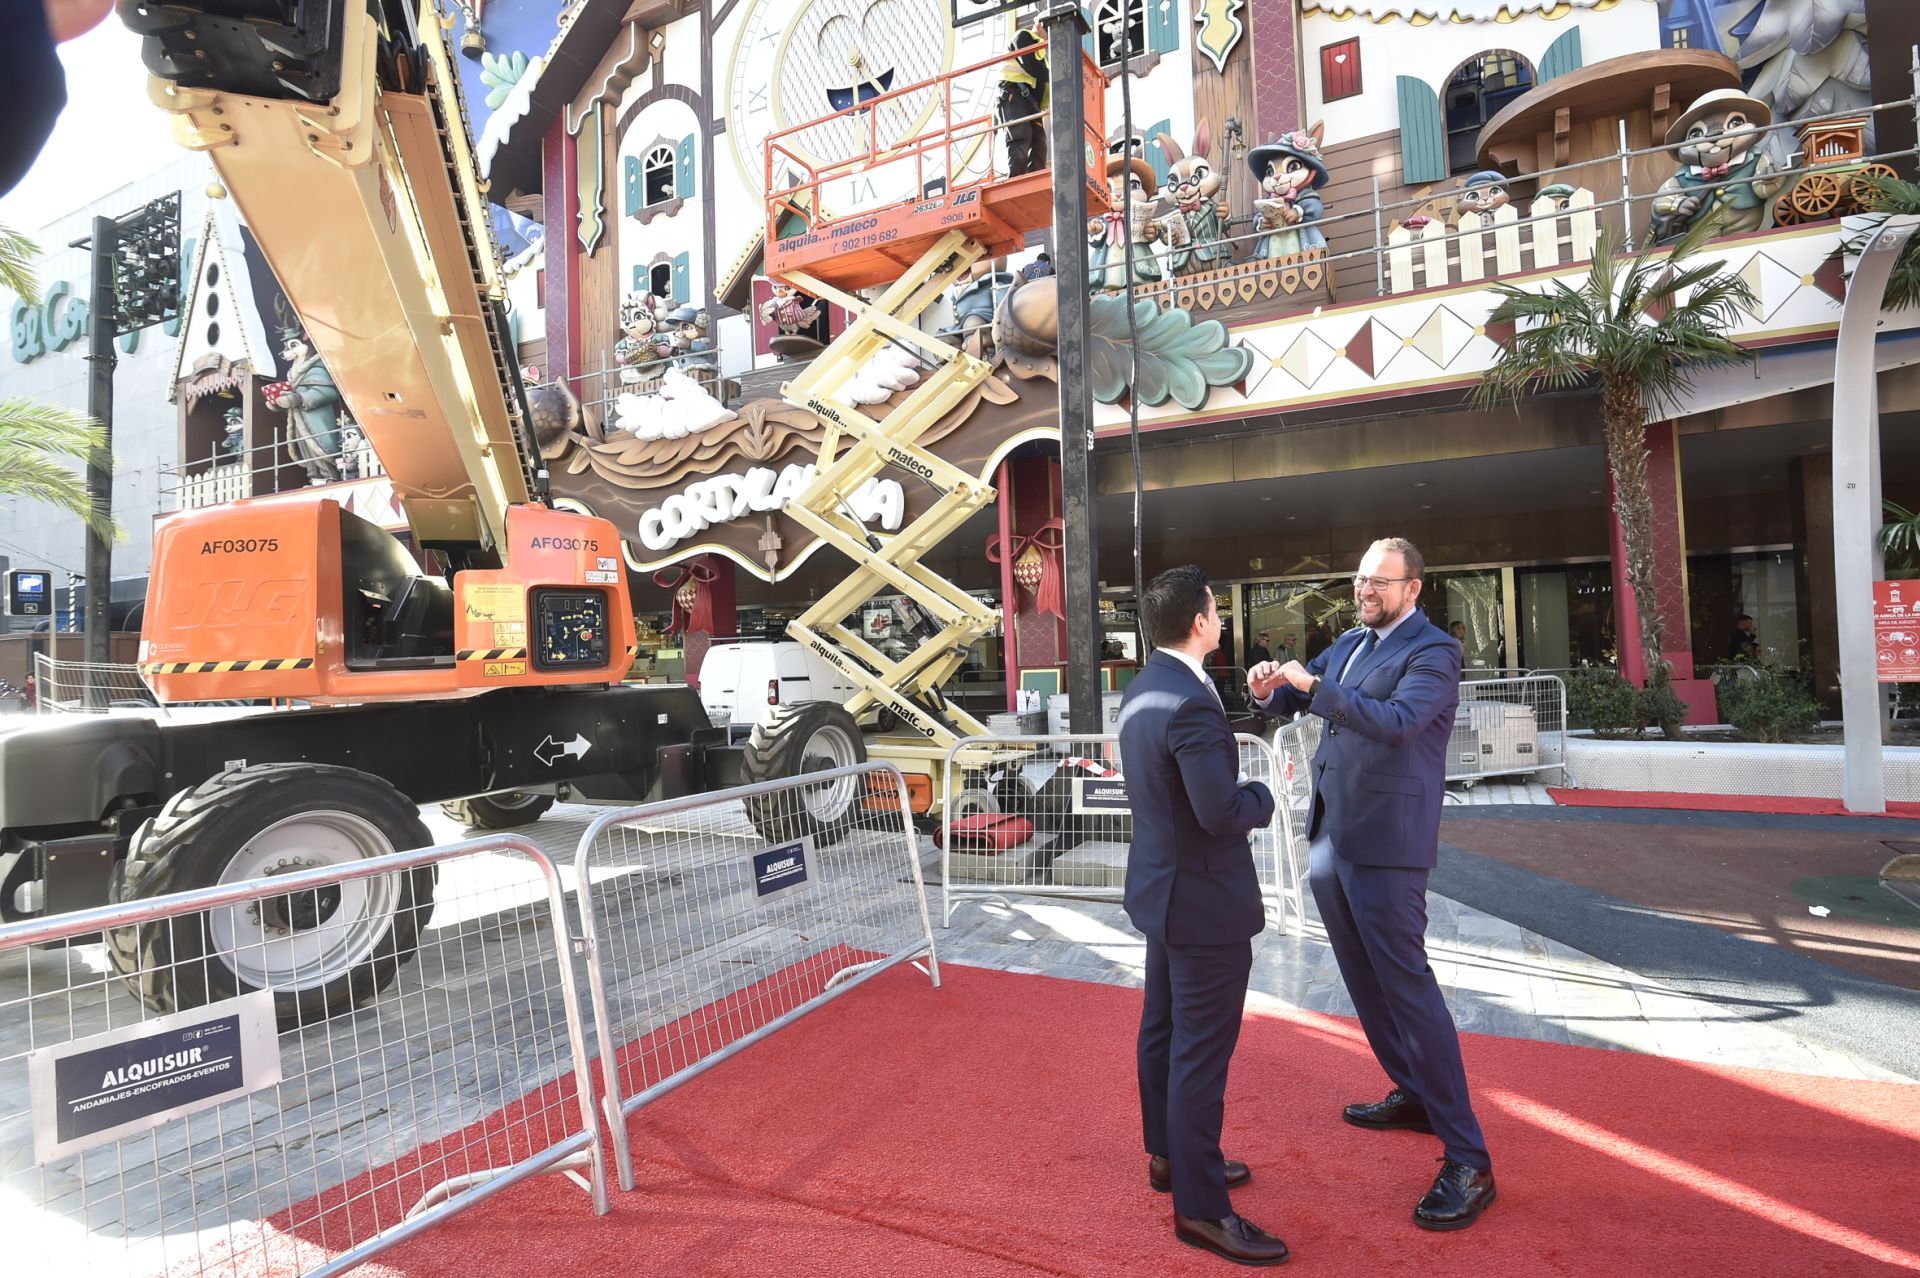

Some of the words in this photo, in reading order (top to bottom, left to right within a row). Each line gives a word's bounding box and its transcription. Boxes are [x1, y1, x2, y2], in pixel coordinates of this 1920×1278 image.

[952, 190, 977, 206] JLG
[1086, 175, 1109, 203] ateco
[941, 212, 964, 225] 3908
[842, 237, 860, 251] 902
[863, 234, 877, 248] 119
[879, 228, 898, 243] 682
[11, 296, 46, 363] El
[888, 446, 934, 479] mateco
[201, 538, 279, 555] AF03075
[531, 537, 599, 552] AF03075
[169, 578, 308, 631] JLG
[766, 857, 795, 874] ALQUISUR
[102, 1046, 203, 1089] ALQUISUR
